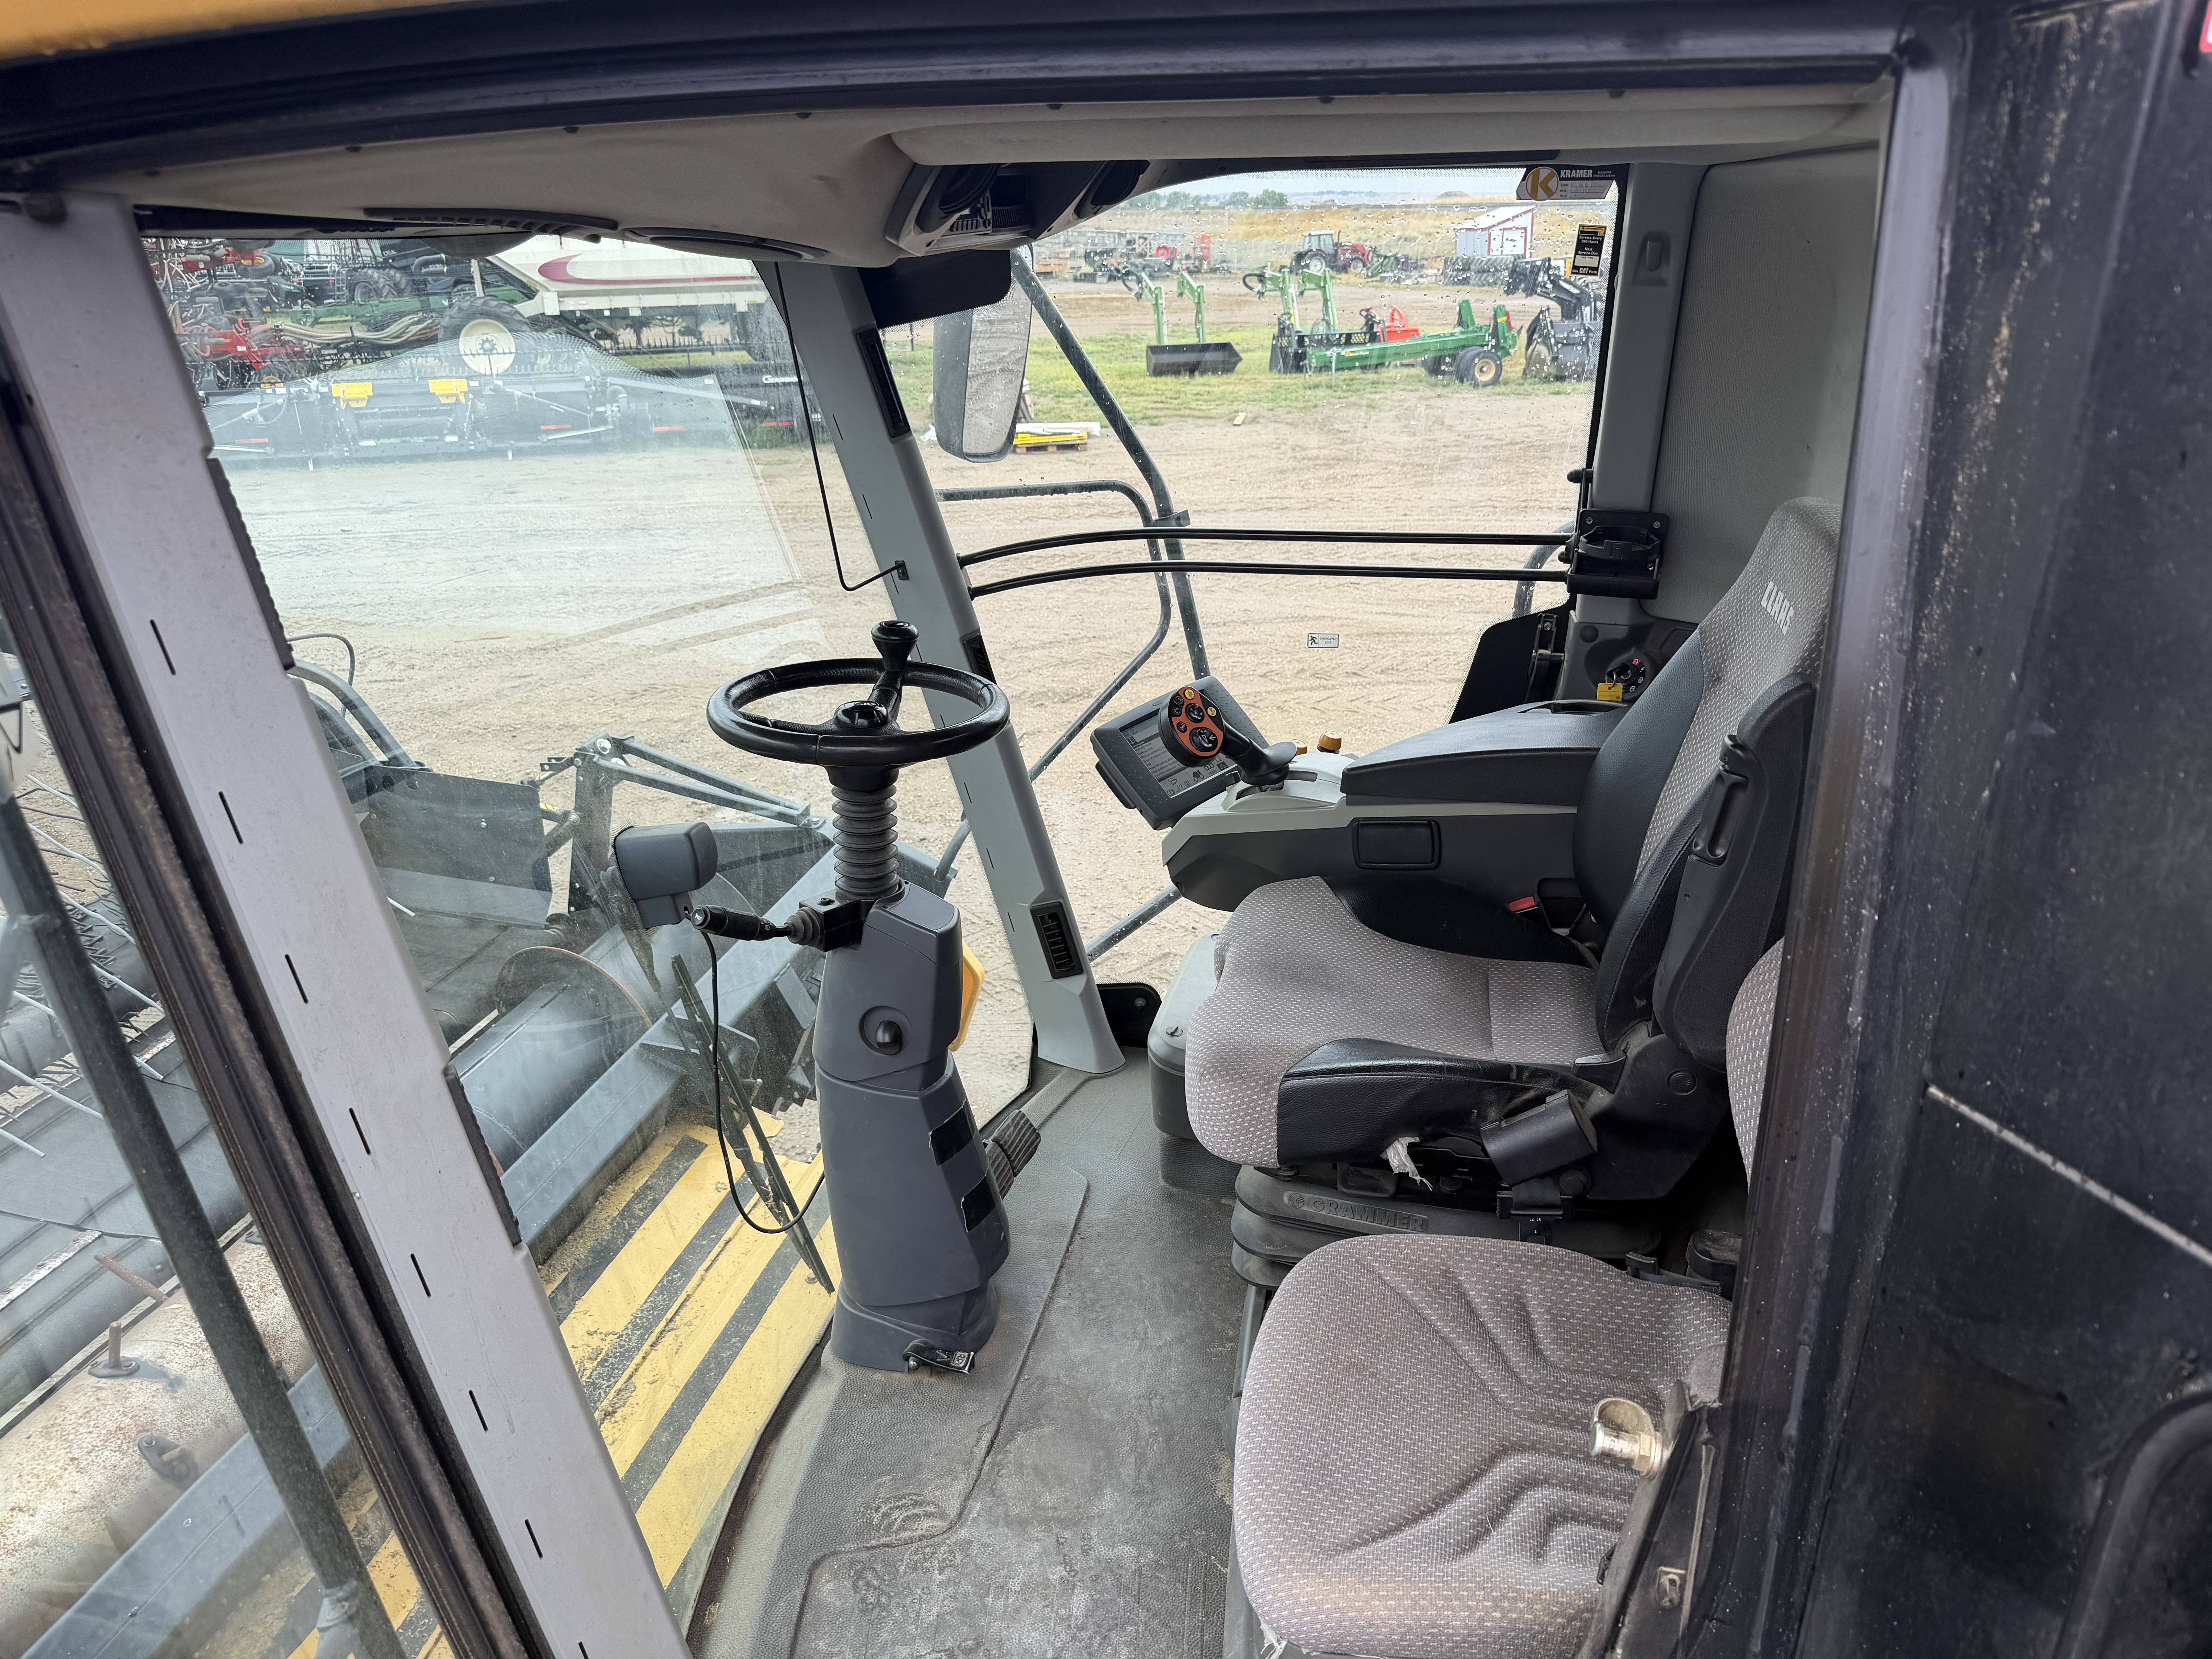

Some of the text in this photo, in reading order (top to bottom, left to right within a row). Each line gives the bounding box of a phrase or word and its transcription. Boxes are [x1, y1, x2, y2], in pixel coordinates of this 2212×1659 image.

[1560, 170, 1592, 178] KRAMER
[1761, 580, 1795, 636] CLAAS
[1311, 1198, 1424, 1232] GRAMMER
